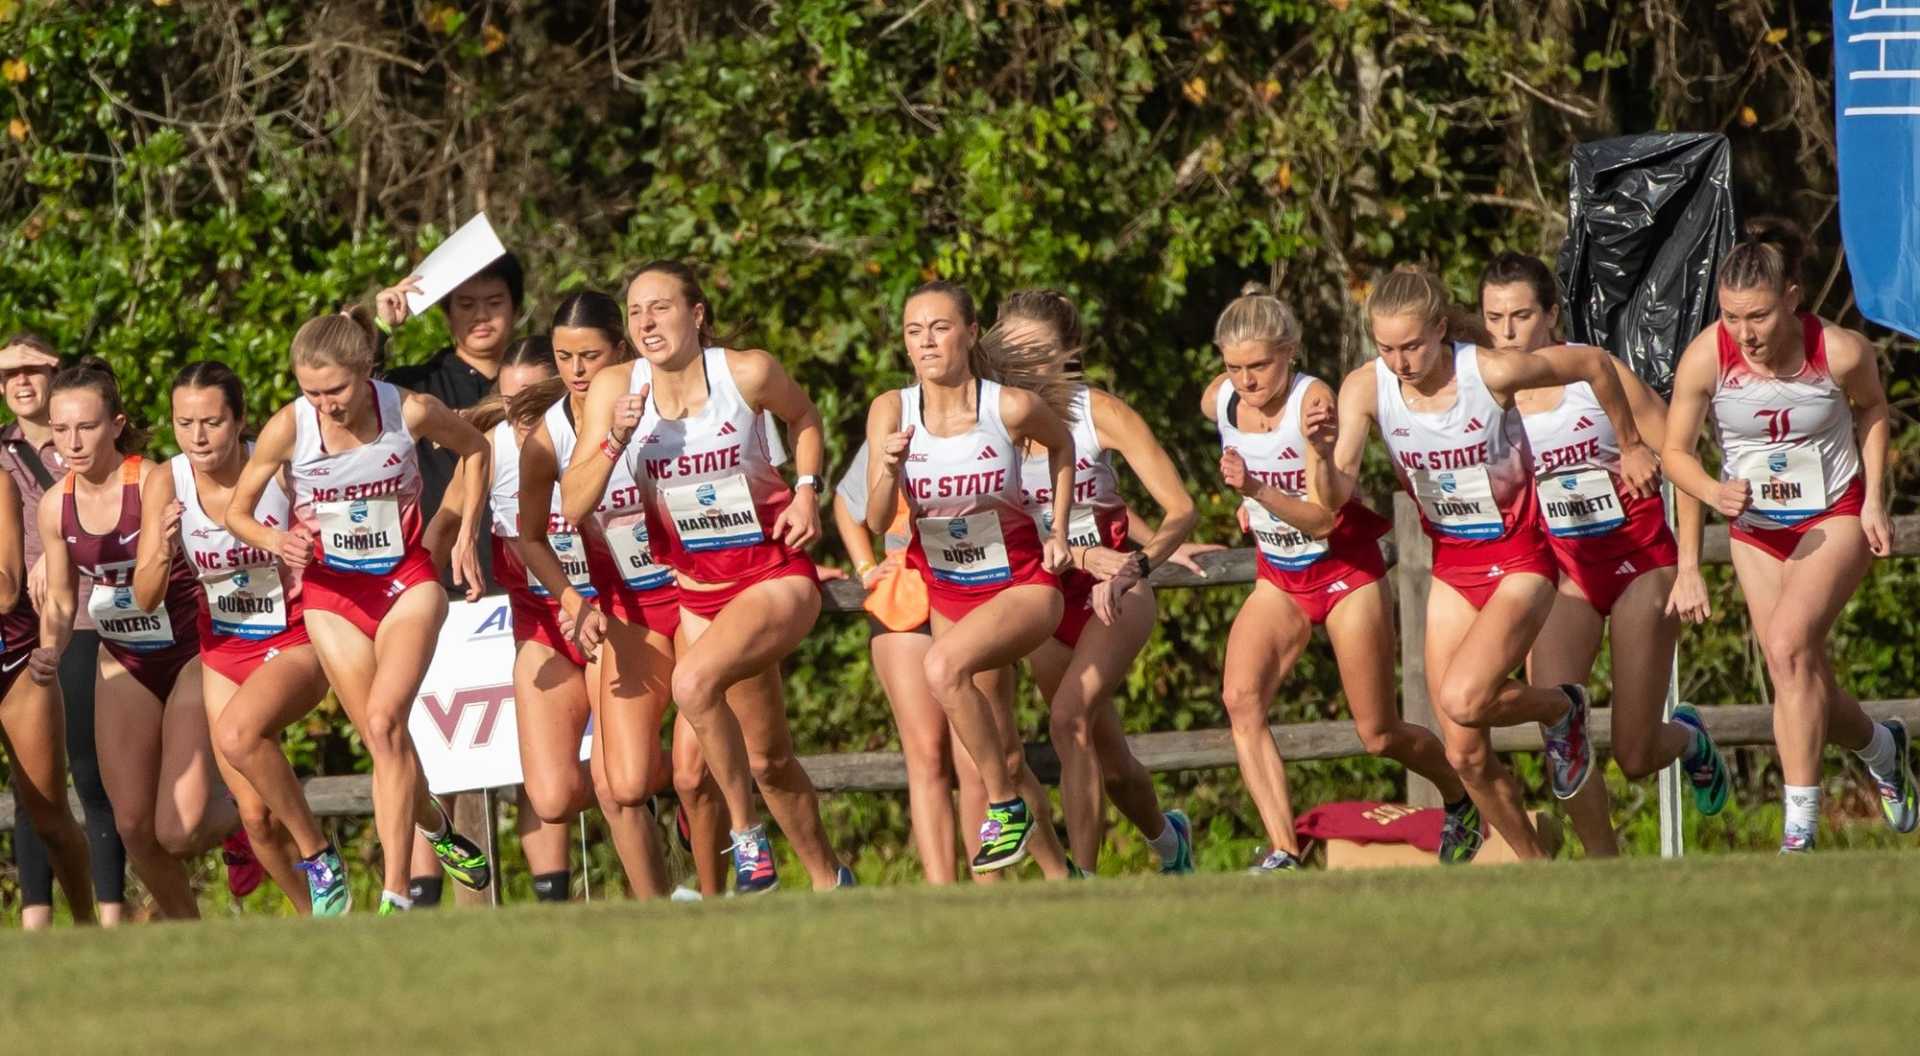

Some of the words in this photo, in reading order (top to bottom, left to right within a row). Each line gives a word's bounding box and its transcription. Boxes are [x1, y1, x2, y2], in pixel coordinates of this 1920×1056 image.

[646, 457, 672, 479] NC
[678, 444, 741, 476] STATE
[1400, 449, 1425, 470] NC
[1428, 440, 1488, 470] STATE
[1541, 436, 1600, 472] STATE
[312, 486, 338, 502] NC
[345, 473, 405, 501] STATE
[904, 478, 931, 499] NC
[938, 468, 1006, 498] STATE
[1760, 482, 1802, 499] PENN
[1546, 494, 1613, 518] HOWLETT
[677, 510, 755, 532] HARTMAN
[333, 531, 391, 550] CHMIEL
[195, 550, 222, 569] NC
[943, 546, 987, 563] BUSH
[218, 595, 274, 614] QUARZO
[100, 615, 161, 634] WATERS
[418, 681, 515, 750] VT
